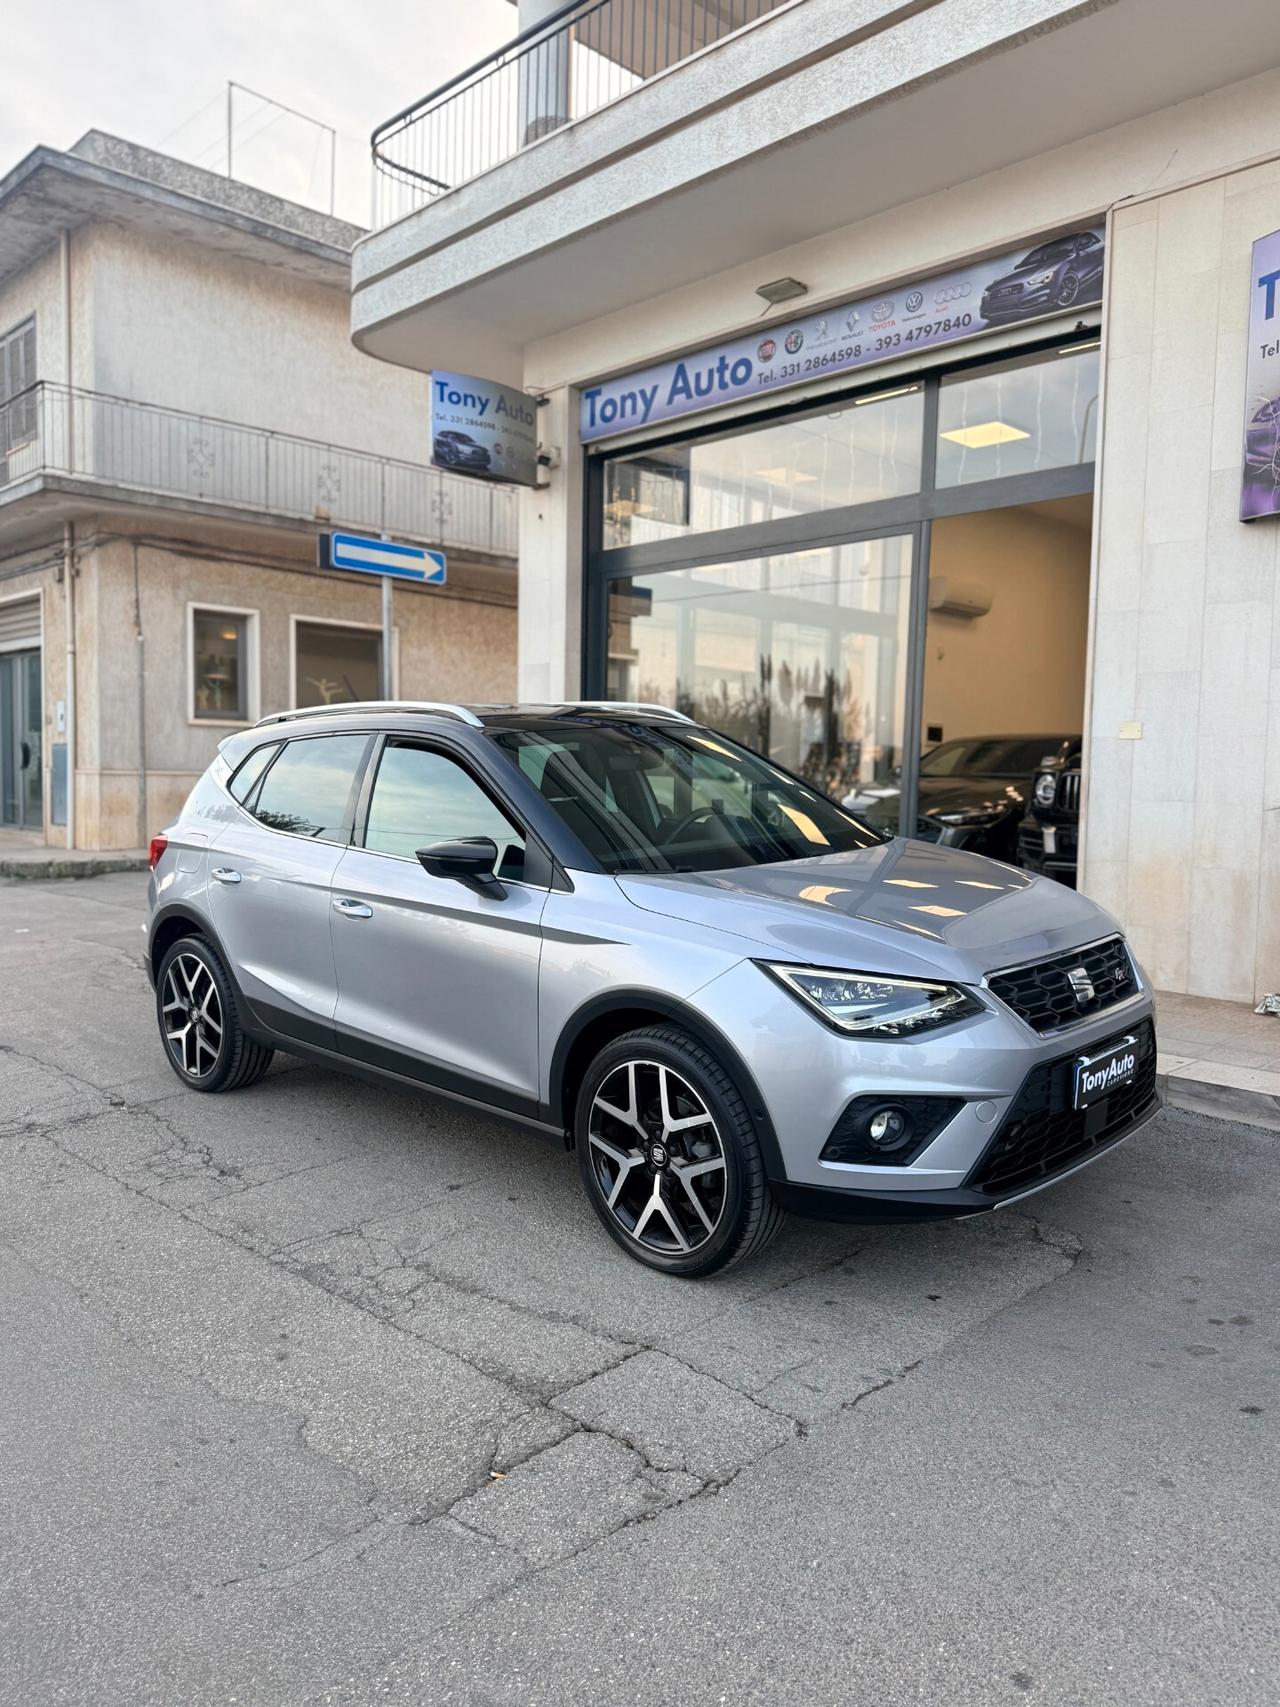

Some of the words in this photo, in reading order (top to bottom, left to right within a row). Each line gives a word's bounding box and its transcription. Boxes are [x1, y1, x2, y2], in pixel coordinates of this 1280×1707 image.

[757, 369, 776, 385] Tel.
[781, 362, 801, 378] 331
[804, 344, 862, 372] 2864598
[875, 332, 901, 351] 393
[905, 313, 972, 342] 4797840
[868, 320, 896, 333] TOYOTA
[435, 380, 490, 416] Tony
[495, 394, 534, 427] Auto
[584, 388, 660, 428] Tony
[666, 355, 753, 406] Auto
